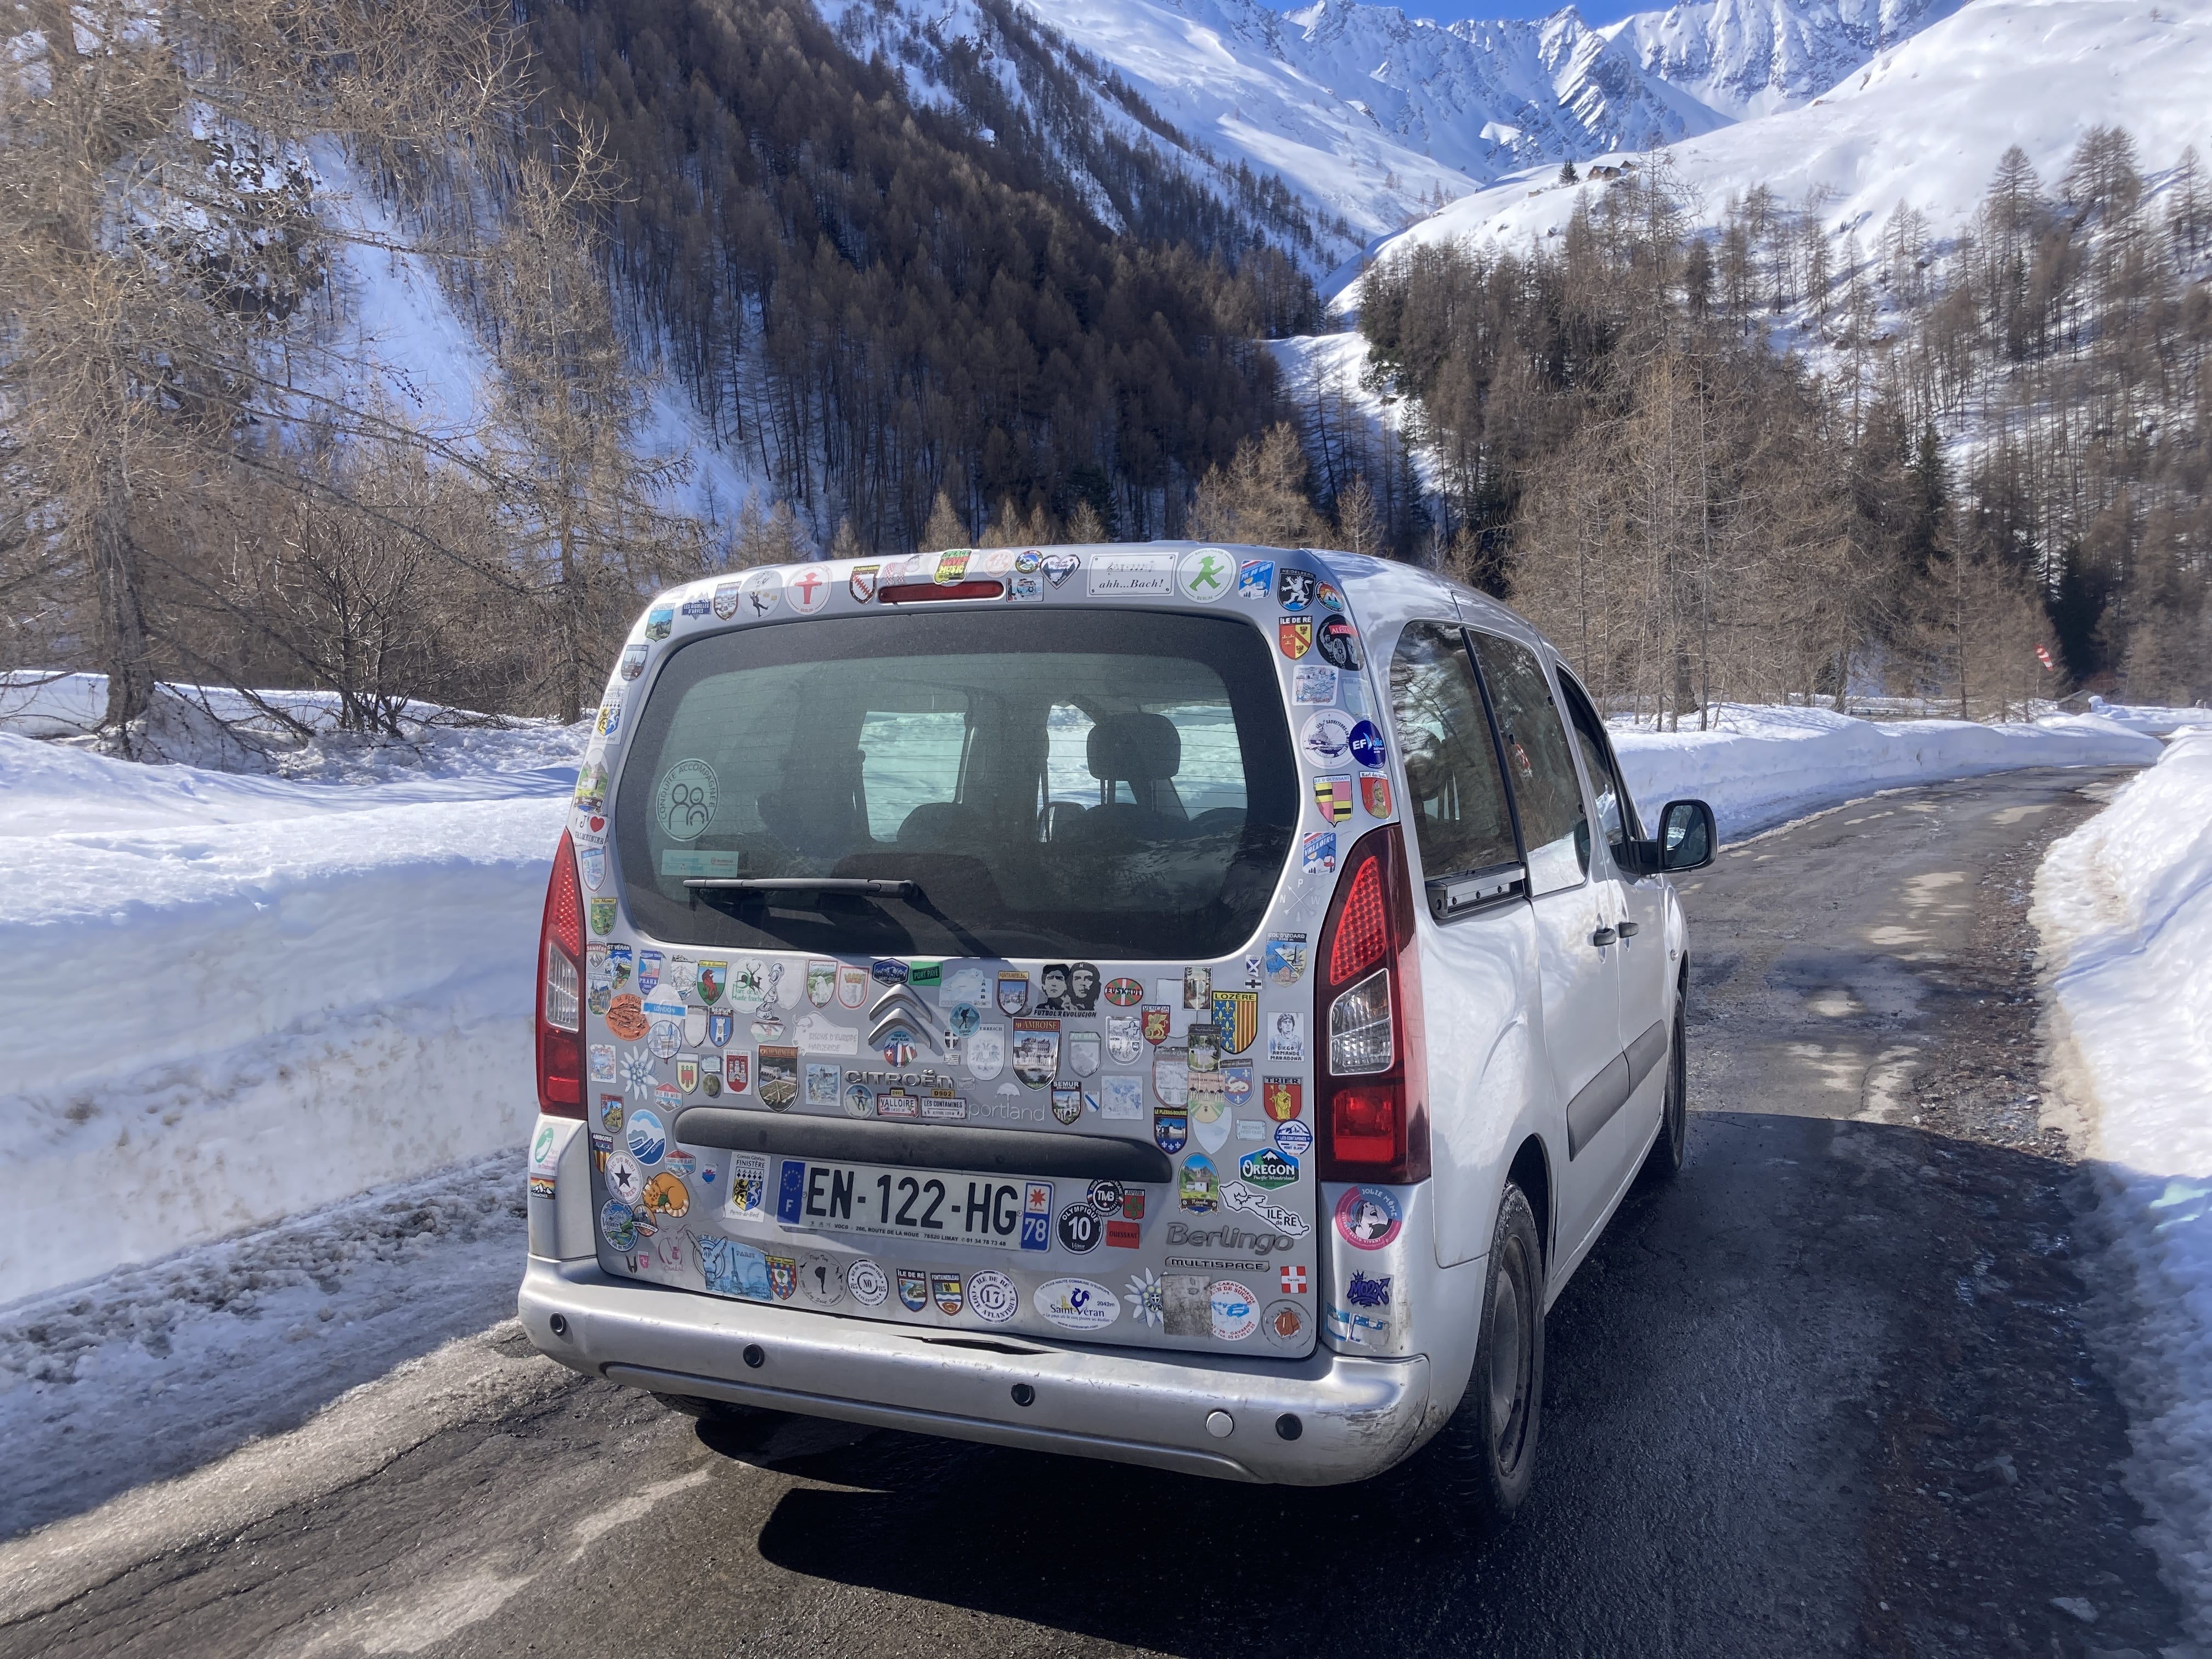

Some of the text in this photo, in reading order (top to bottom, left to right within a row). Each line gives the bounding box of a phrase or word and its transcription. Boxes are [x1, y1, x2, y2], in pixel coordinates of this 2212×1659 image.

[943, 556, 969, 566] LOVE
[938, 563, 964, 575] MUSIC
[1241, 572, 1249, 581] PIC
[1259, 562, 1272, 573] MIDI
[1282, 569, 1314, 577] HEIDELBERG
[1099, 579, 1164, 589] ahh...Bach!
[1280, 616, 1290, 624] ÎLE
[1352, 739, 1367, 751] EF
[659, 772, 677, 820] CONDUITE
[575, 831, 605, 845] VALMEINIER
[1304, 833, 1335, 856] VALLOIRE
[1297, 878, 1304, 888] P
[913, 967, 939, 979] PORT PAYÉ
[1106, 988, 1142, 996] EUSKADI
[1215, 992, 1255, 1001] LOZÈRE
[624, 995, 642, 1005] FLOUR
[1058, 1010, 1097, 1018] REVOLUCION
[1023, 1020, 1057, 1030] AMBOISE
[611, 1026, 622, 1037] HAUTE
[829, 1033, 857, 1042] D'EUROPE
[808, 1043, 840, 1052] MARGERIDE
[844, 1069, 954, 1089] CITROËN
[881, 1098, 915, 1108] VALLOIRE
[968, 1102, 1045, 1121] portland
[592, 1134, 612, 1143] AMBOISE
[624, 1158, 636, 1172] MIDI
[736, 1158, 765, 1169] FINISTÈRE
[1242, 1159, 1295, 1178] OREGON
[806, 1167, 1018, 1235] EN-122-HG
[1097, 1190, 1115, 1201] TMB
[786, 1199, 794, 1212] F
[1362, 1188, 1397, 1217] JOLIE MÔME
[730, 1209, 759, 1218] Penn-ar-Bed
[1061, 1206, 1099, 1223] OLYMPIQUE
[1095, 1205, 1121, 1217] CONTAMINES
[1267, 1209, 1283, 1220] ILE
[1284, 1216, 1297, 1227] RE
[1024, 1217, 1047, 1242] 78
[1068, 1216, 1091, 1241] 10
[1166, 1222, 1294, 1256] Berlingo
[1171, 1259, 1264, 1270] MULTISPACE
[917, 1271, 925, 1279] RÉ
[976, 1275, 988, 1284] ILE
[998, 1278, 1010, 1289] RÉ
[985, 1290, 1001, 1304] 17
[1218, 1282, 1256, 1304] CARAVANEIGE
[1233, 1288, 1252, 1306] SUCRE
[970, 1290, 1015, 1319] CÔTE ATLANTIQUE
[1050, 1304, 1074, 1314] Saint
[1229, 1321, 1252, 1335] GAVARNIE
